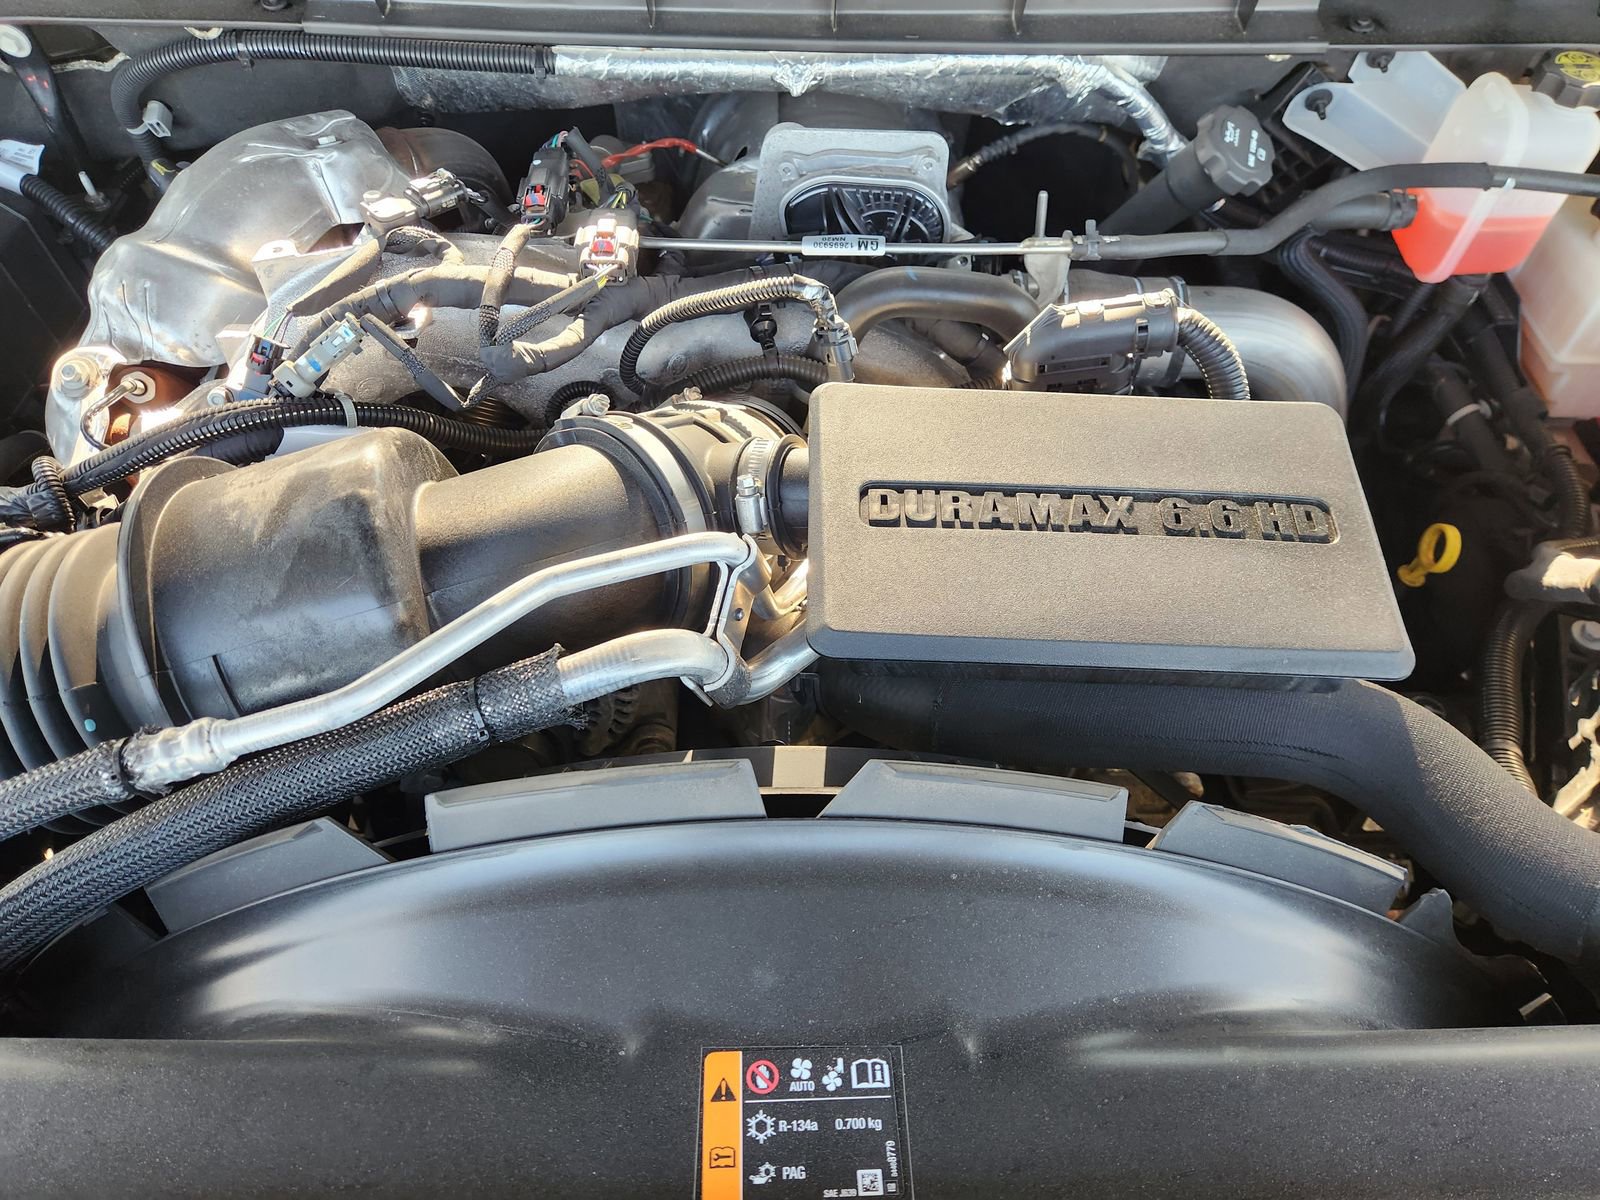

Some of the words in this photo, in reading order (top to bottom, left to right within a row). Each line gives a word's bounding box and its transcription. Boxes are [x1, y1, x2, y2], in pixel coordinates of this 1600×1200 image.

[858, 240, 879, 251] GM
[868, 488, 1137, 534] DURAMAX
[1159, 498, 1246, 539] 6.6
[1255, 502, 1330, 544] HD
[789, 1081, 815, 1092] AUTO
[778, 1119, 818, 1132] R-134a
[835, 1118, 867, 1131] 0.700
[867, 1117, 883, 1131] kg
[782, 1166, 806, 1180] PAG
[823, 1189, 839, 1198] SAE
